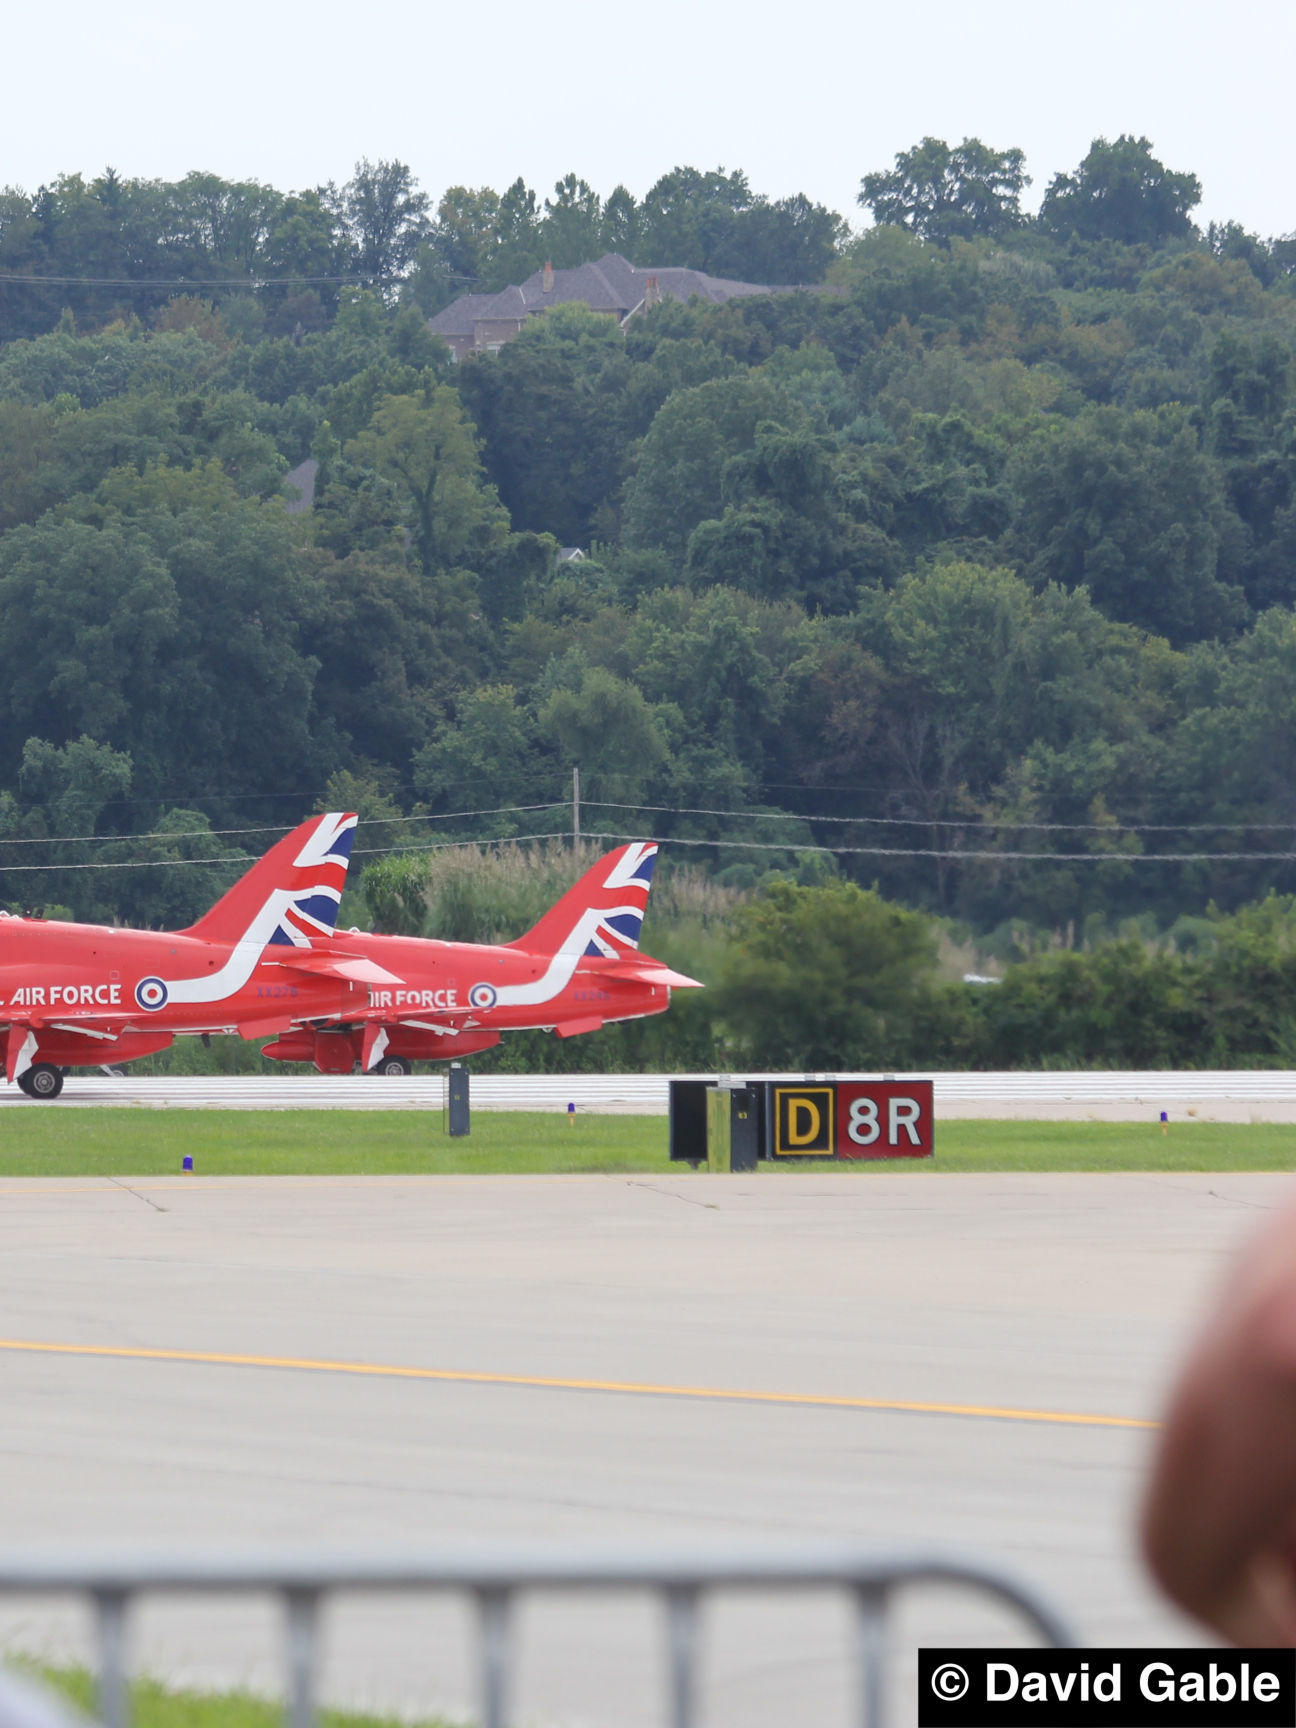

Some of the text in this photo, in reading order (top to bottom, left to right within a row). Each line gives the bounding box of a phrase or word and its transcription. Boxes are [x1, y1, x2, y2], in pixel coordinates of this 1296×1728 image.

[9, 987, 46, 1005] AIR
[50, 984, 121, 1005] FORCE
[396, 989, 457, 1008] FORCE
[788, 1097, 921, 1145] D 8R
